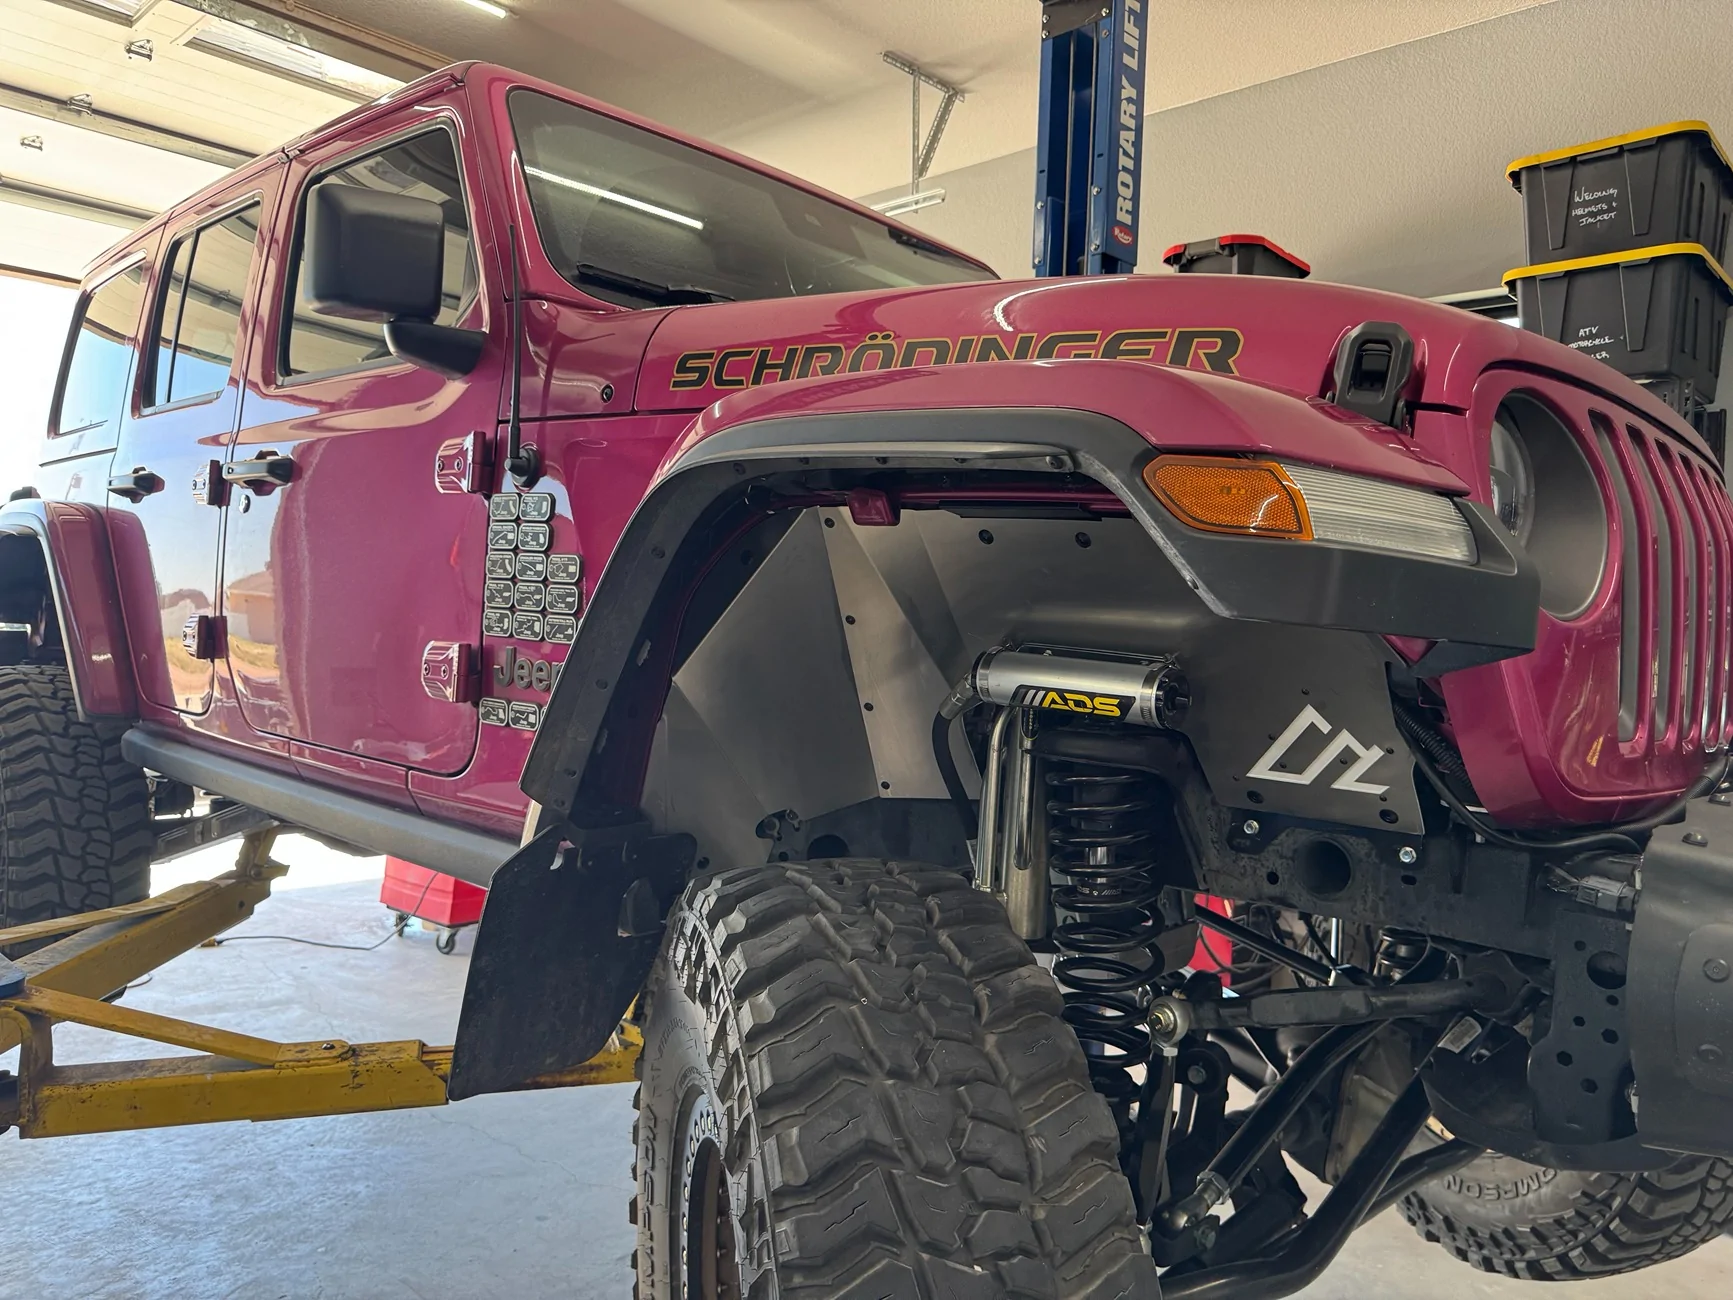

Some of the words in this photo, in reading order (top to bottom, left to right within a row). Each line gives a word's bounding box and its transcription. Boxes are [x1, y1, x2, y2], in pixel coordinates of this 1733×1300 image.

[1122, 0, 1141, 71] LIFT
[1116, 74, 1137, 226] ROTARY
[669, 327, 1245, 392] SCHRÖDINGER
[1578, 325, 1599, 338] ATV
[1443, 1166, 1558, 1202] OMPSON
